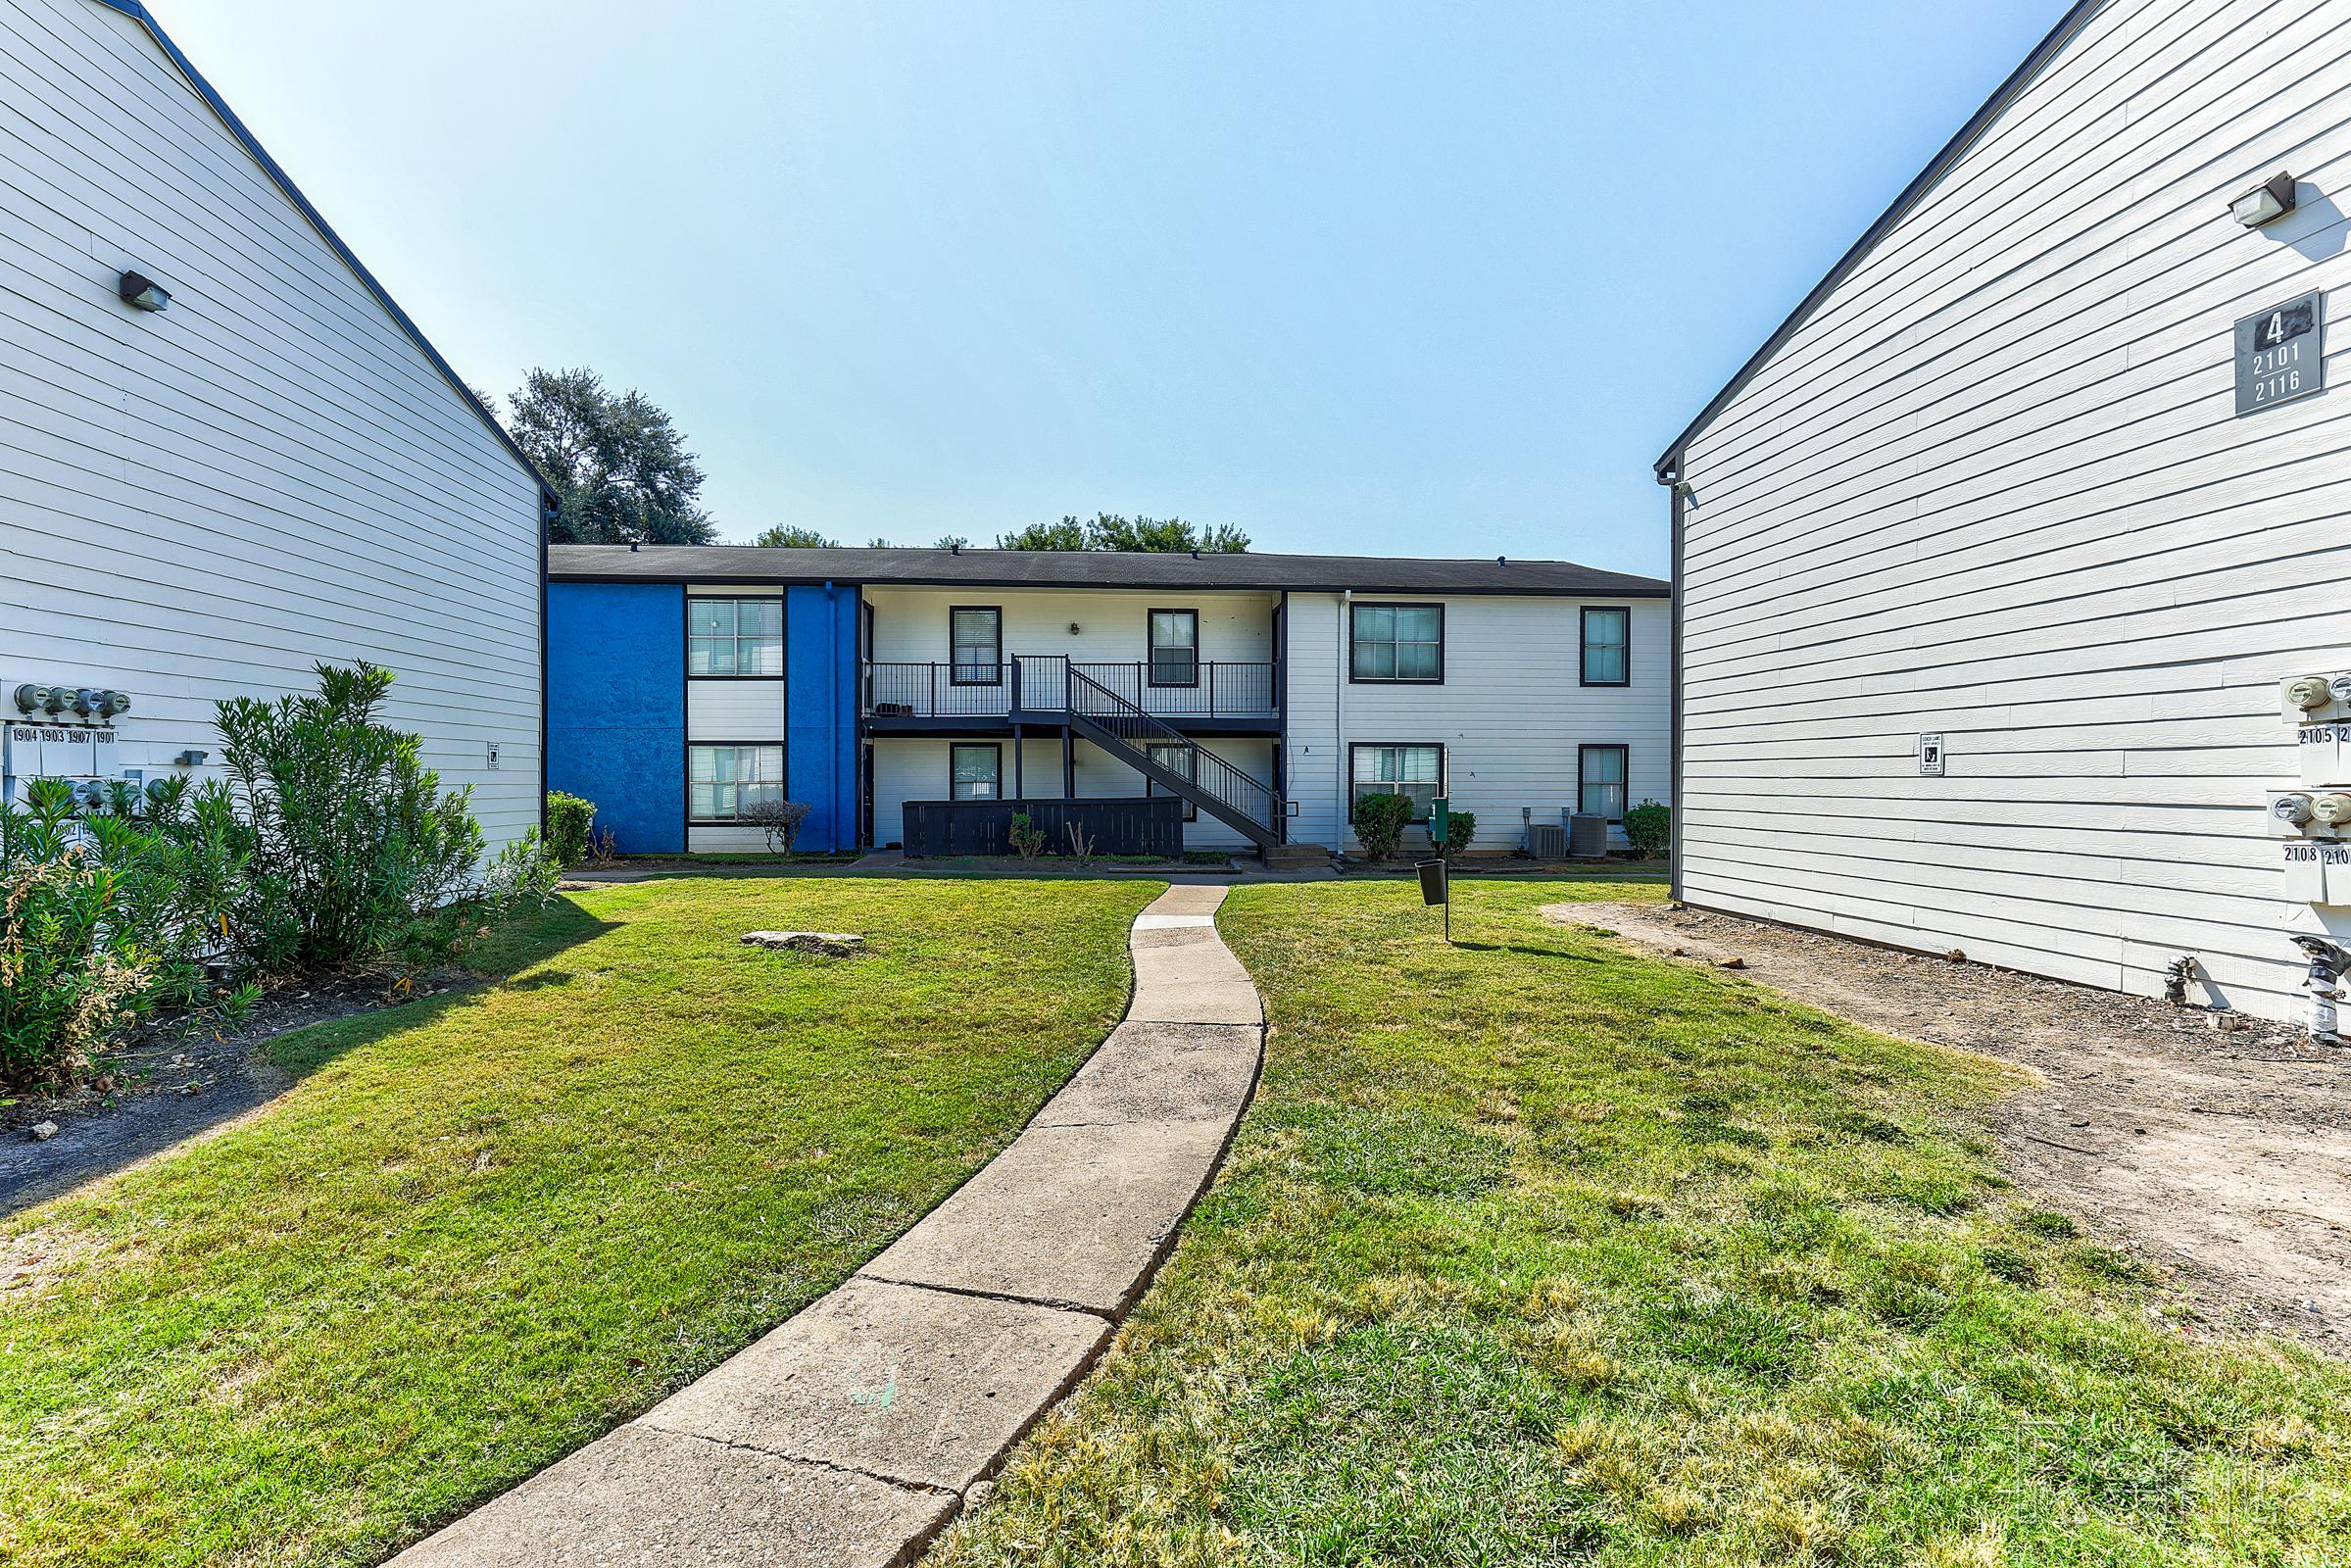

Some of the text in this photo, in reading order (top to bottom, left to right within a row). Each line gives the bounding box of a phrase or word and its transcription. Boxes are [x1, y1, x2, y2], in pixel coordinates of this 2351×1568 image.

[2267, 311, 2284, 344] 4
[2253, 342, 2299, 375] 2101
[2255, 370, 2300, 402] 2116
[13, 729, 115, 744] 1904 1903 1907 1901
[2299, 728, 2332, 744] 2105
[2284, 847, 2317, 861] 2108
[2325, 850, 2351, 864] 210
